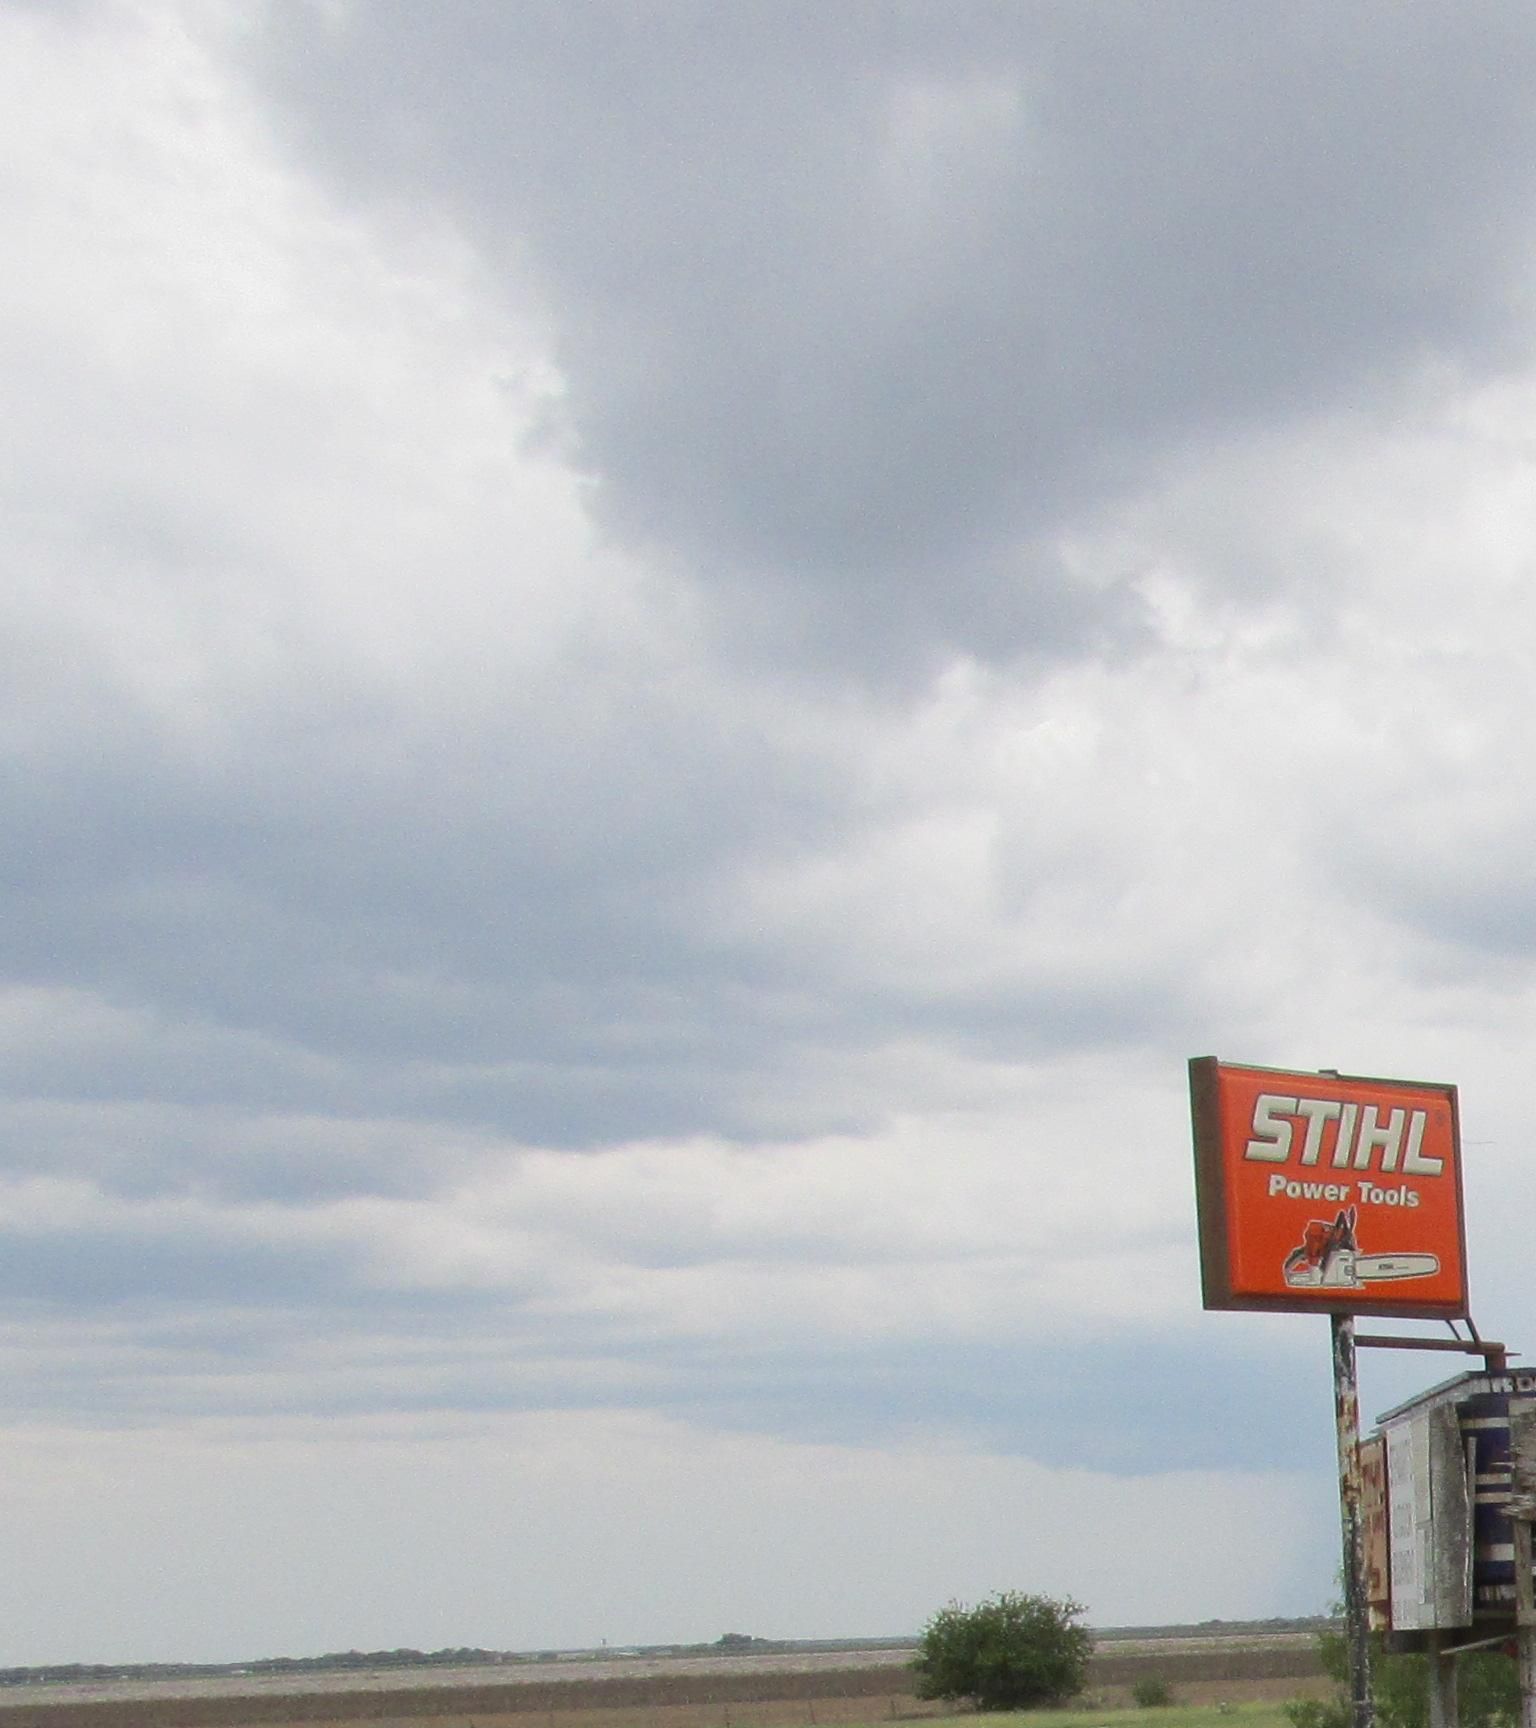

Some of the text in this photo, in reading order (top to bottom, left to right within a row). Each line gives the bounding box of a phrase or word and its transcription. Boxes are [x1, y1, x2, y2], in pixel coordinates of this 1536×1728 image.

[1245, 1093, 1443, 1176] STIHL
[1268, 1174, 1420, 1207] Power Tools
